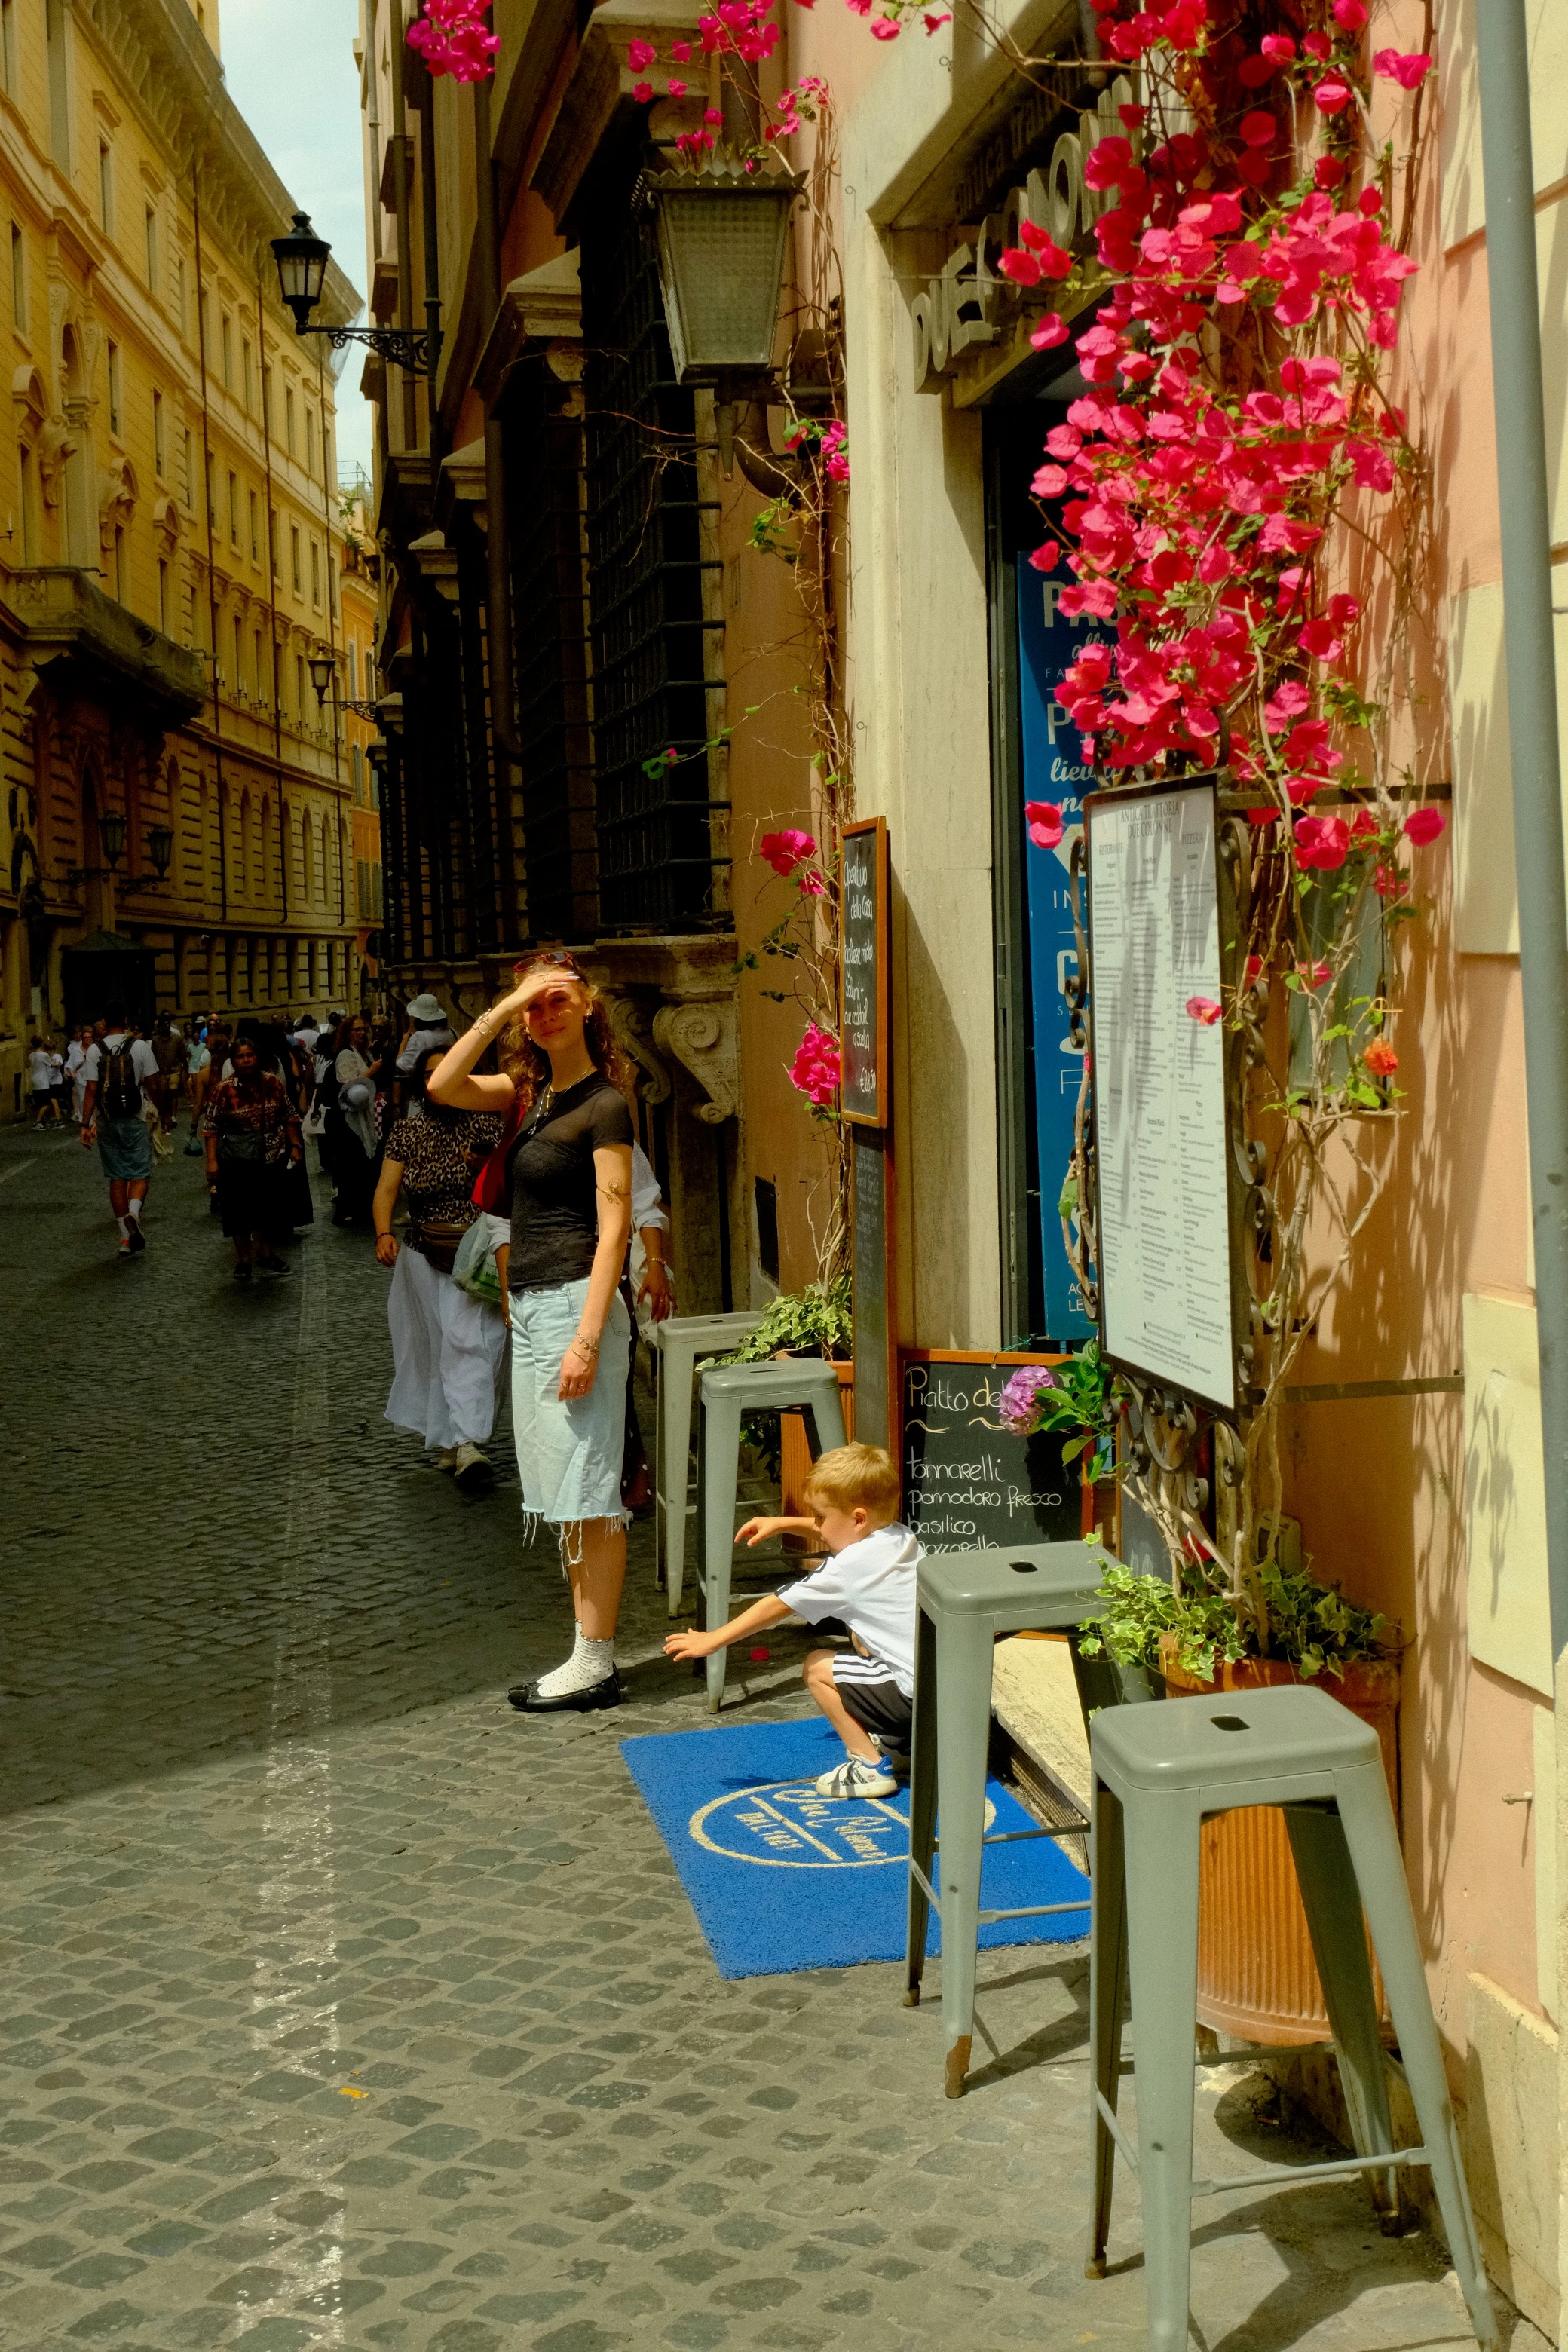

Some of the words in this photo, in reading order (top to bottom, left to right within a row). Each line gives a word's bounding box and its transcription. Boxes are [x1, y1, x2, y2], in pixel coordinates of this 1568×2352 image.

[911, 242, 994, 394] DUE
[1127, 824, 1140, 839] DUE
[1141, 818, 1172, 837] COLONNE
[905, 1366, 969, 1412] Piatto
[907, 1512, 977, 1535] basilico
